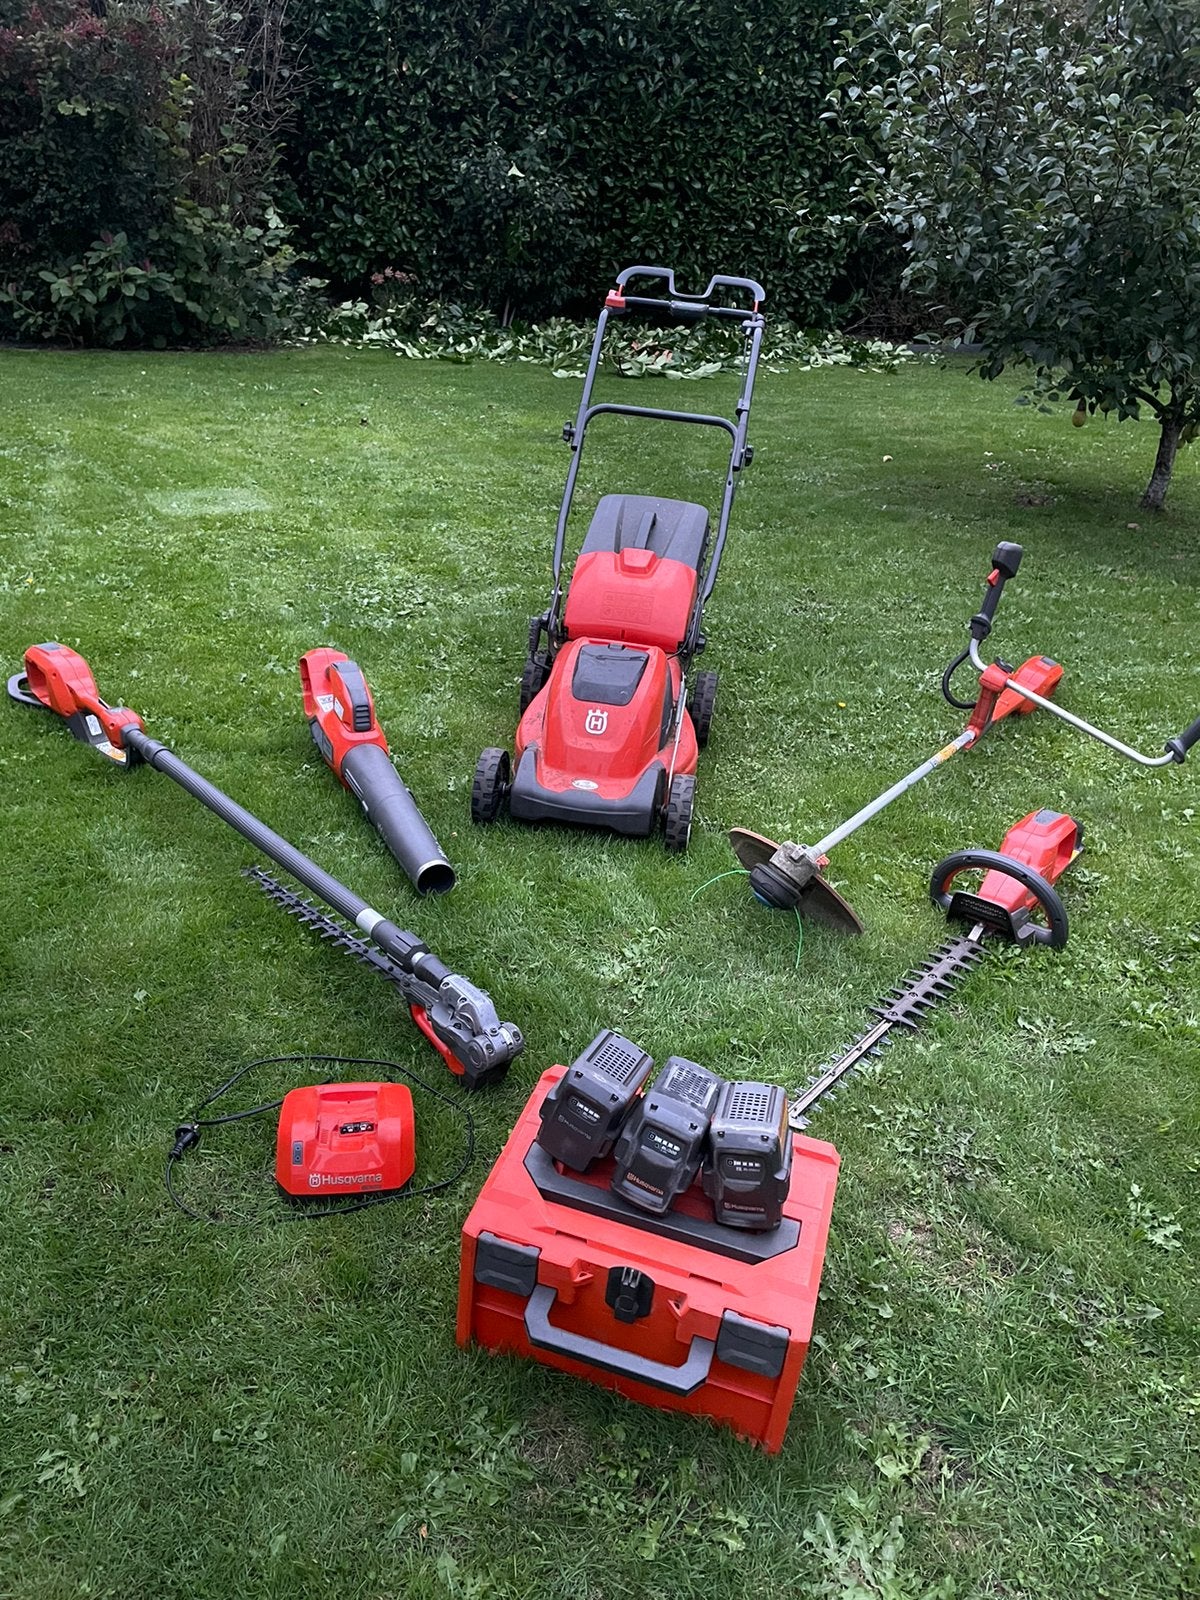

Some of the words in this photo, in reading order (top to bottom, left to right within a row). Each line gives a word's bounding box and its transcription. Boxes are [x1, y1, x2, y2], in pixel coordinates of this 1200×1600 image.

[322, 1173, 383, 1185] Husqvarna
[633, 1175, 664, 1195] Husqvarna
[731, 1203, 765, 1212] Husqvarna
